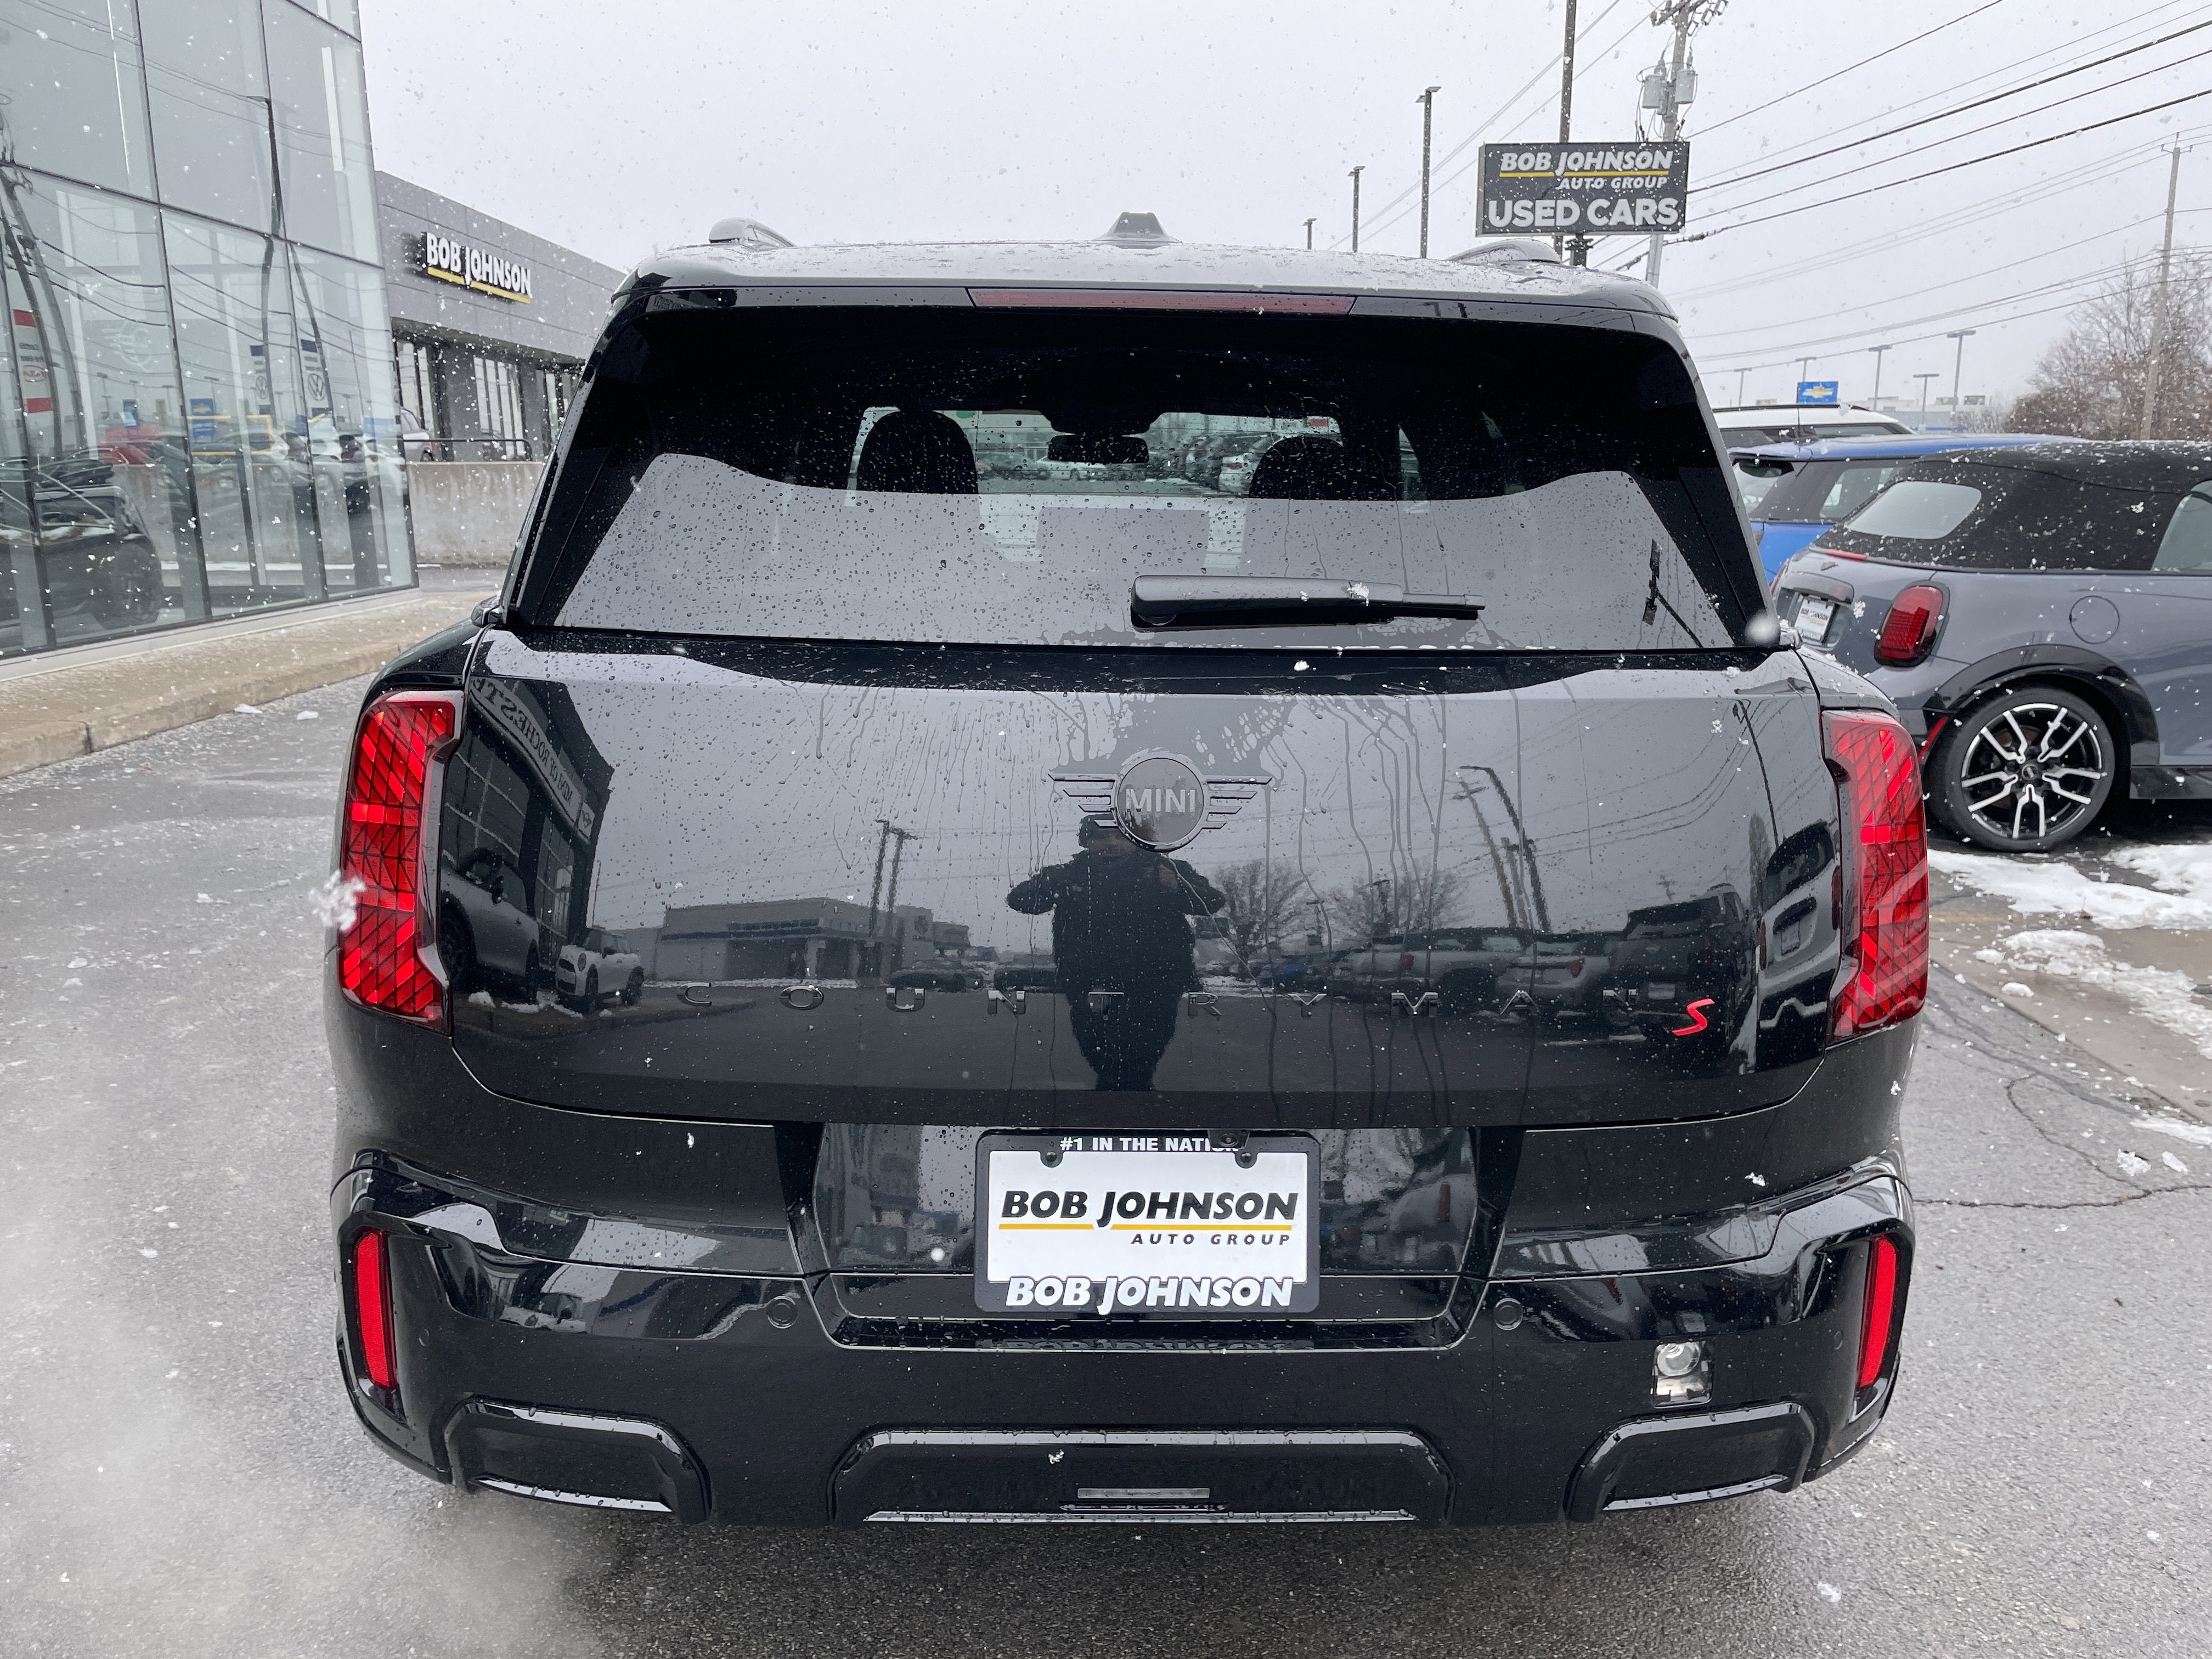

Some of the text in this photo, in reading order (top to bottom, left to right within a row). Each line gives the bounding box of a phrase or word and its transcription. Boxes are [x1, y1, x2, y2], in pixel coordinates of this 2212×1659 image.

[1500, 150, 1673, 176] BOB JOHNSON
[1558, 176, 1668, 190] AUTO GROUP
[1487, 198, 1679, 227] USED CARS
[426, 231, 533, 298] BOB JOHNSON
[1125, 788, 1196, 813] MINI
[676, 982, 1715, 1036] COUNTRYMAN S
[1060, 1137, 1238, 1152] #1 IN THE NATI
[1001, 1190, 1299, 1228] BOB JOHNSON
[1130, 1233, 1290, 1245] AUTO GROUP
[1005, 1277, 1294, 1316] BOB JOHNSON
